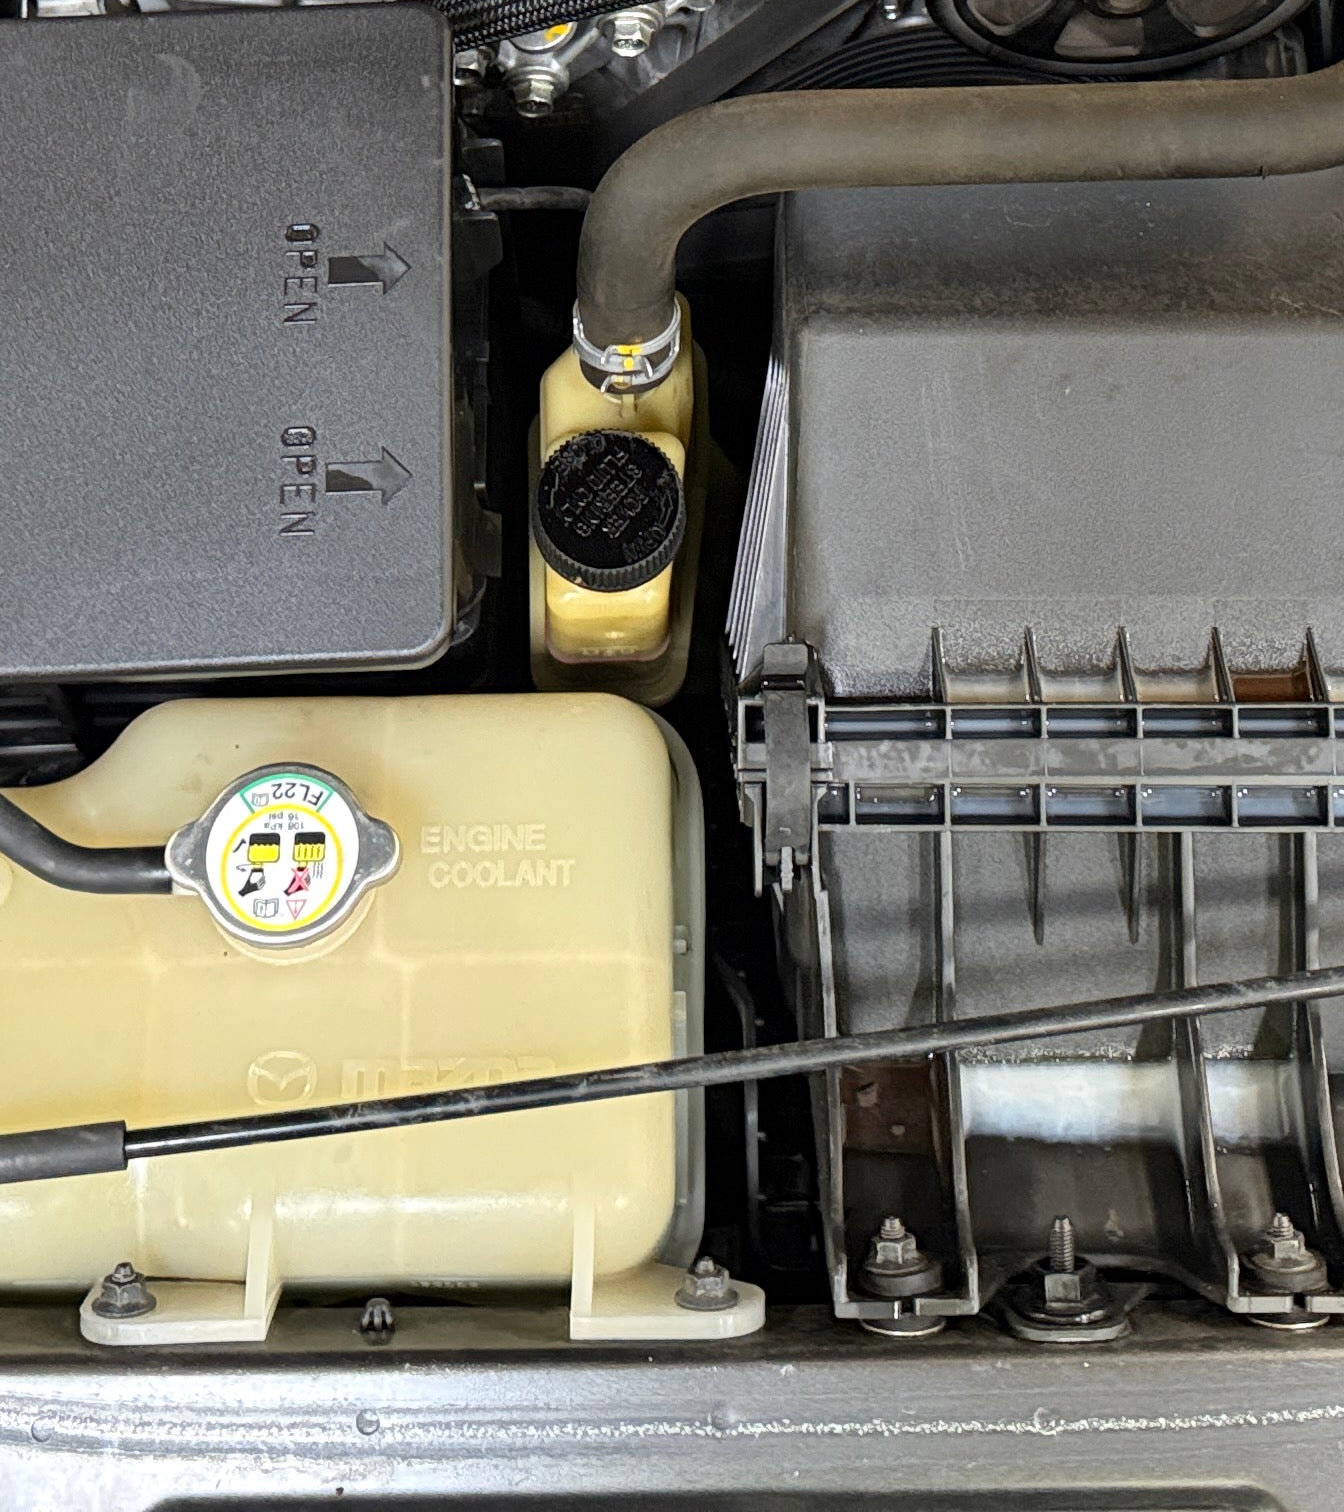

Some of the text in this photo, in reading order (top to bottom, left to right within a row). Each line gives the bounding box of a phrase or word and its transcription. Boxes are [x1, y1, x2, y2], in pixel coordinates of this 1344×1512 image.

[283, 223, 320, 325] OPEN
[279, 425, 317, 537] OPEN
[271, 782, 323, 806] FL22
[421, 823, 546, 853] ENGINE
[428, 858, 576, 888] COOLANT
